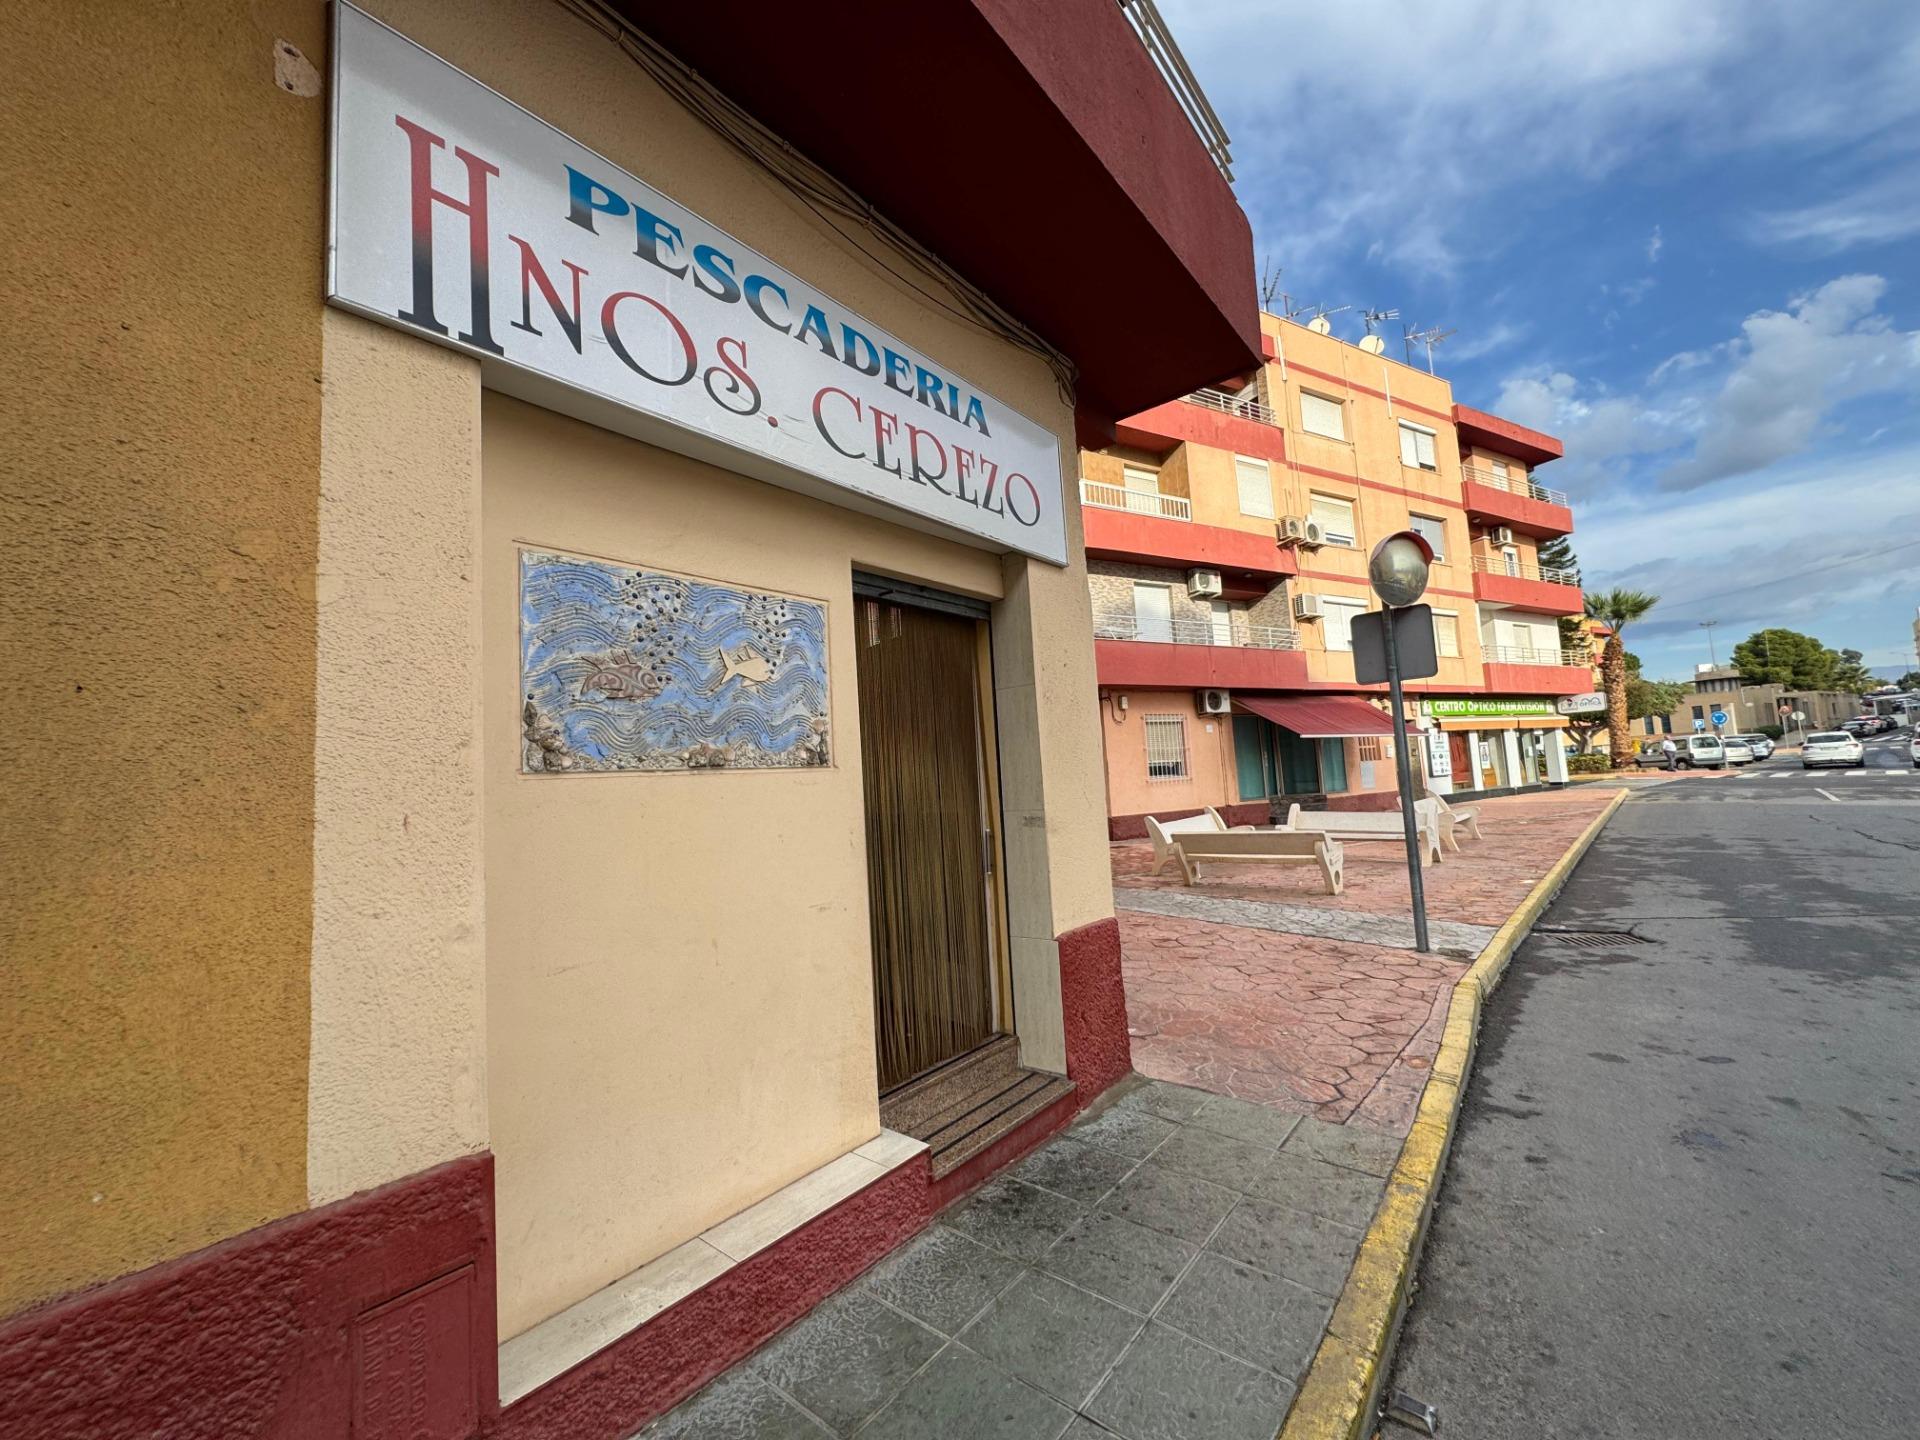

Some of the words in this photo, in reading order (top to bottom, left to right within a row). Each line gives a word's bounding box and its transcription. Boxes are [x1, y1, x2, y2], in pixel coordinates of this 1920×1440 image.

[563, 164, 991, 438] PESCADERIA
[812, 386, 1041, 527] CEREZO
[1434, 701, 1465, 713] CENTRO
